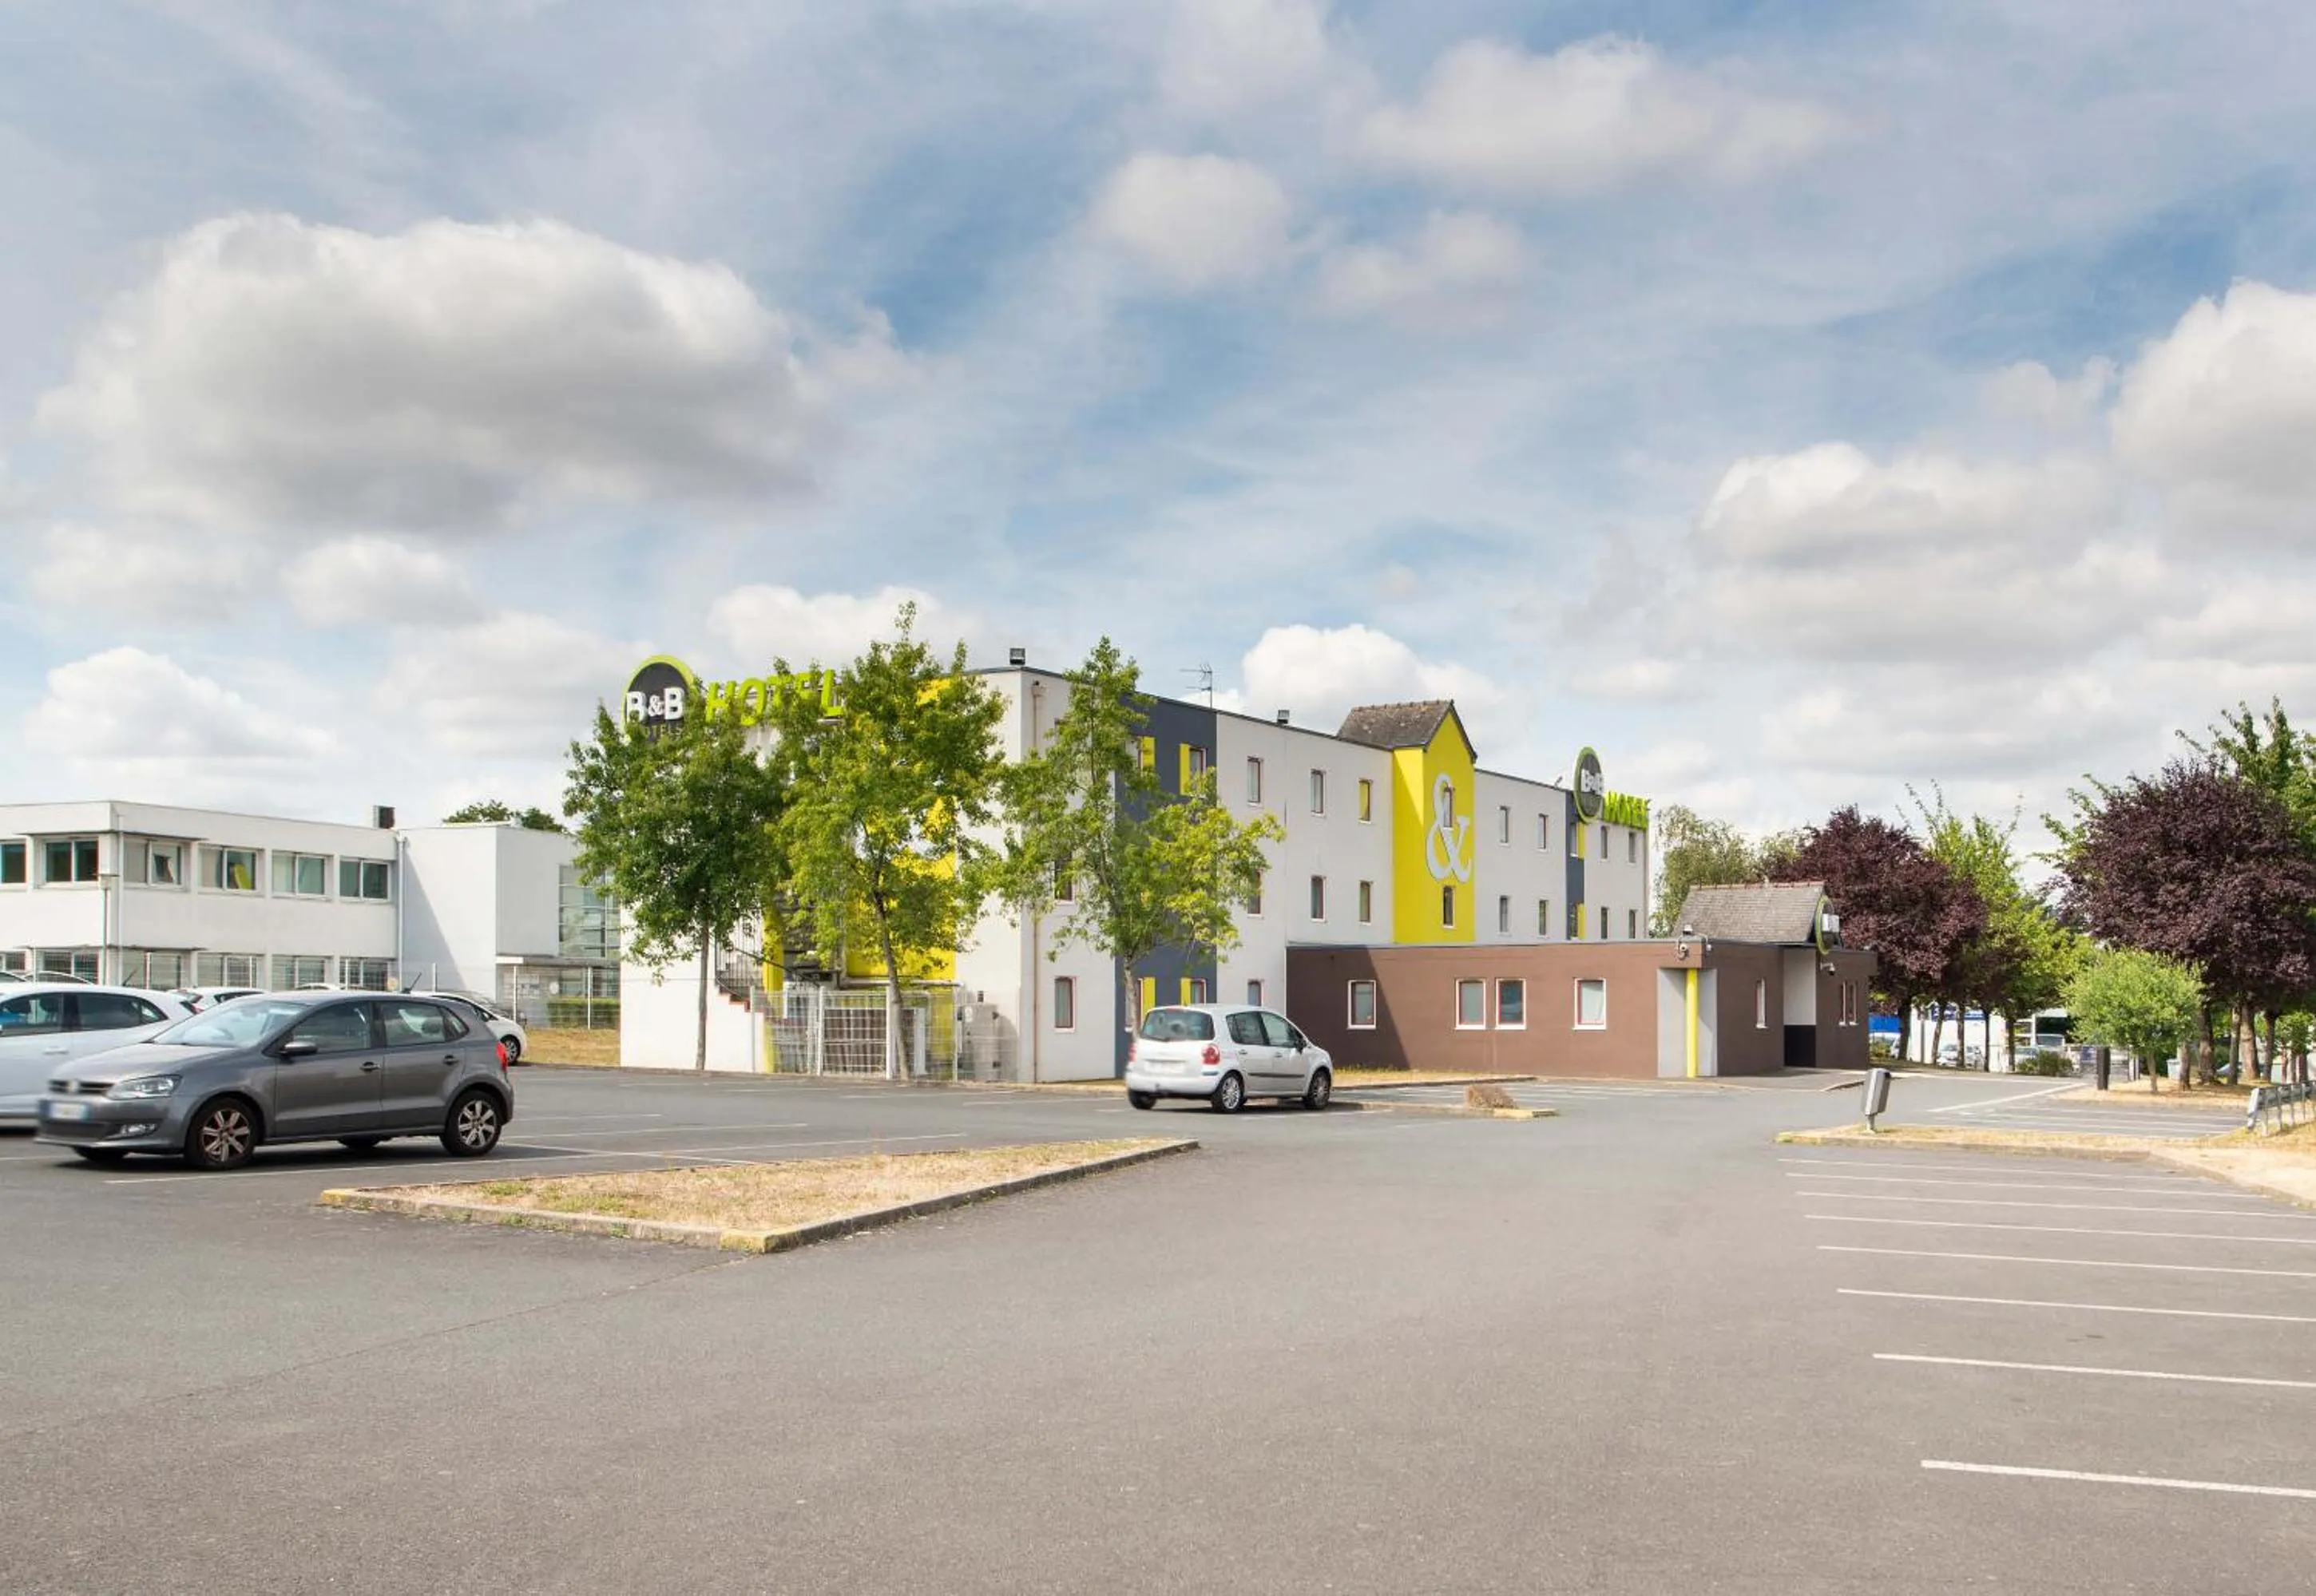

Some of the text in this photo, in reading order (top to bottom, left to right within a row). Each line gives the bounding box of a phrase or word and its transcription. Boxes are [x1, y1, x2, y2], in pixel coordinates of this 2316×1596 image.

[626, 668, 844, 726] B&B HOTEL
[1426, 773, 1472, 884] &
